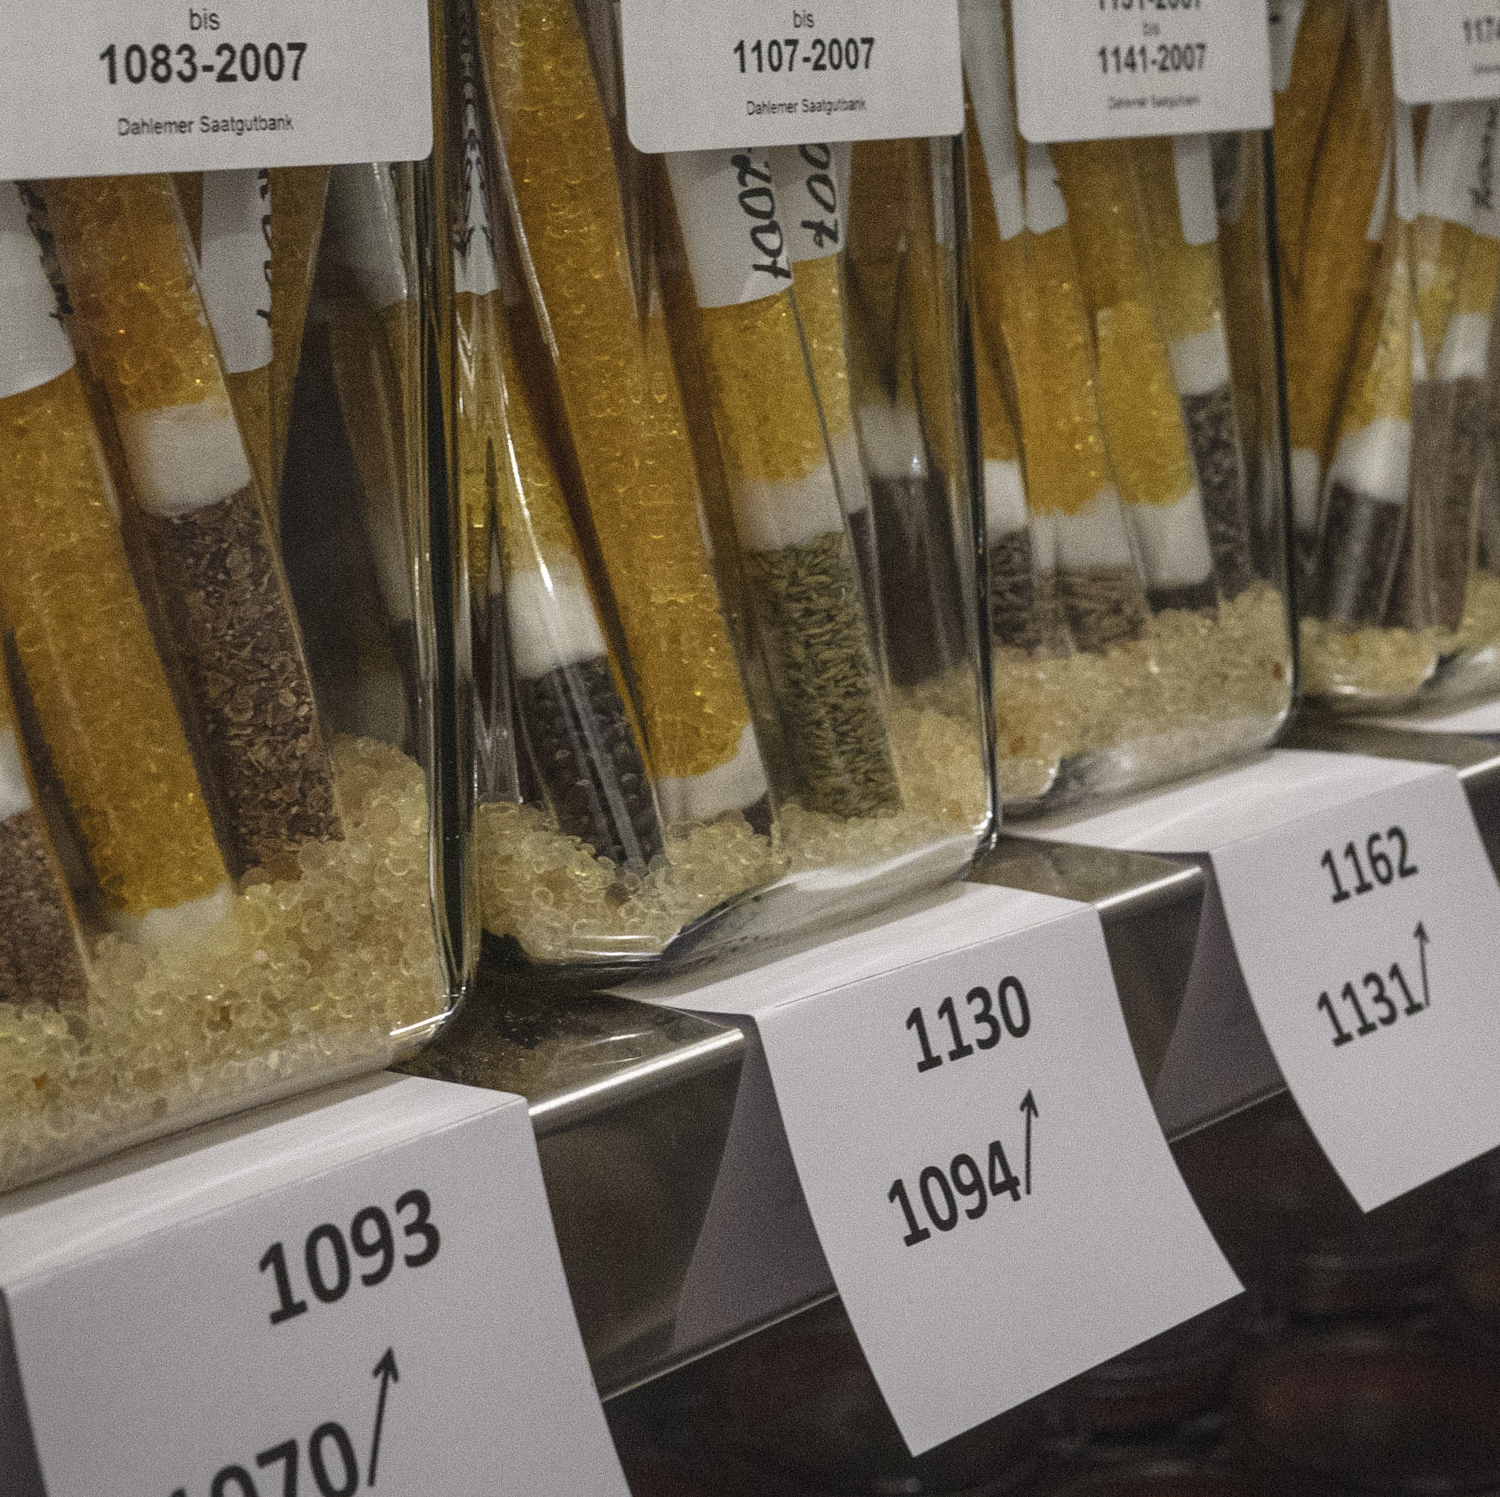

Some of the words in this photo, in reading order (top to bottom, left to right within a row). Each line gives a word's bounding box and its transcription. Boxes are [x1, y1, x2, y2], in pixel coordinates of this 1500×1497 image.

[189, 8, 220, 30] bis
[793, 10, 815, 28] bis
[100, 42, 307, 84] 1083-2007
[734, 37, 874, 73] 1107-2007
[1099, 43, 1206, 74] 1141-2007
[117, 118, 194, 136] Dahlemer
[200, 114, 294, 136] Saatgutbank
[1320, 825, 1419, 903] 1162
[904, 975, 1033, 1073] 1130
[1317, 962, 1424, 1047] 1131
[887, 1140, 1021, 1248] 1094
[258, 1188, 443, 1326] 1093
[168, 1421, 360, 1497] 70
